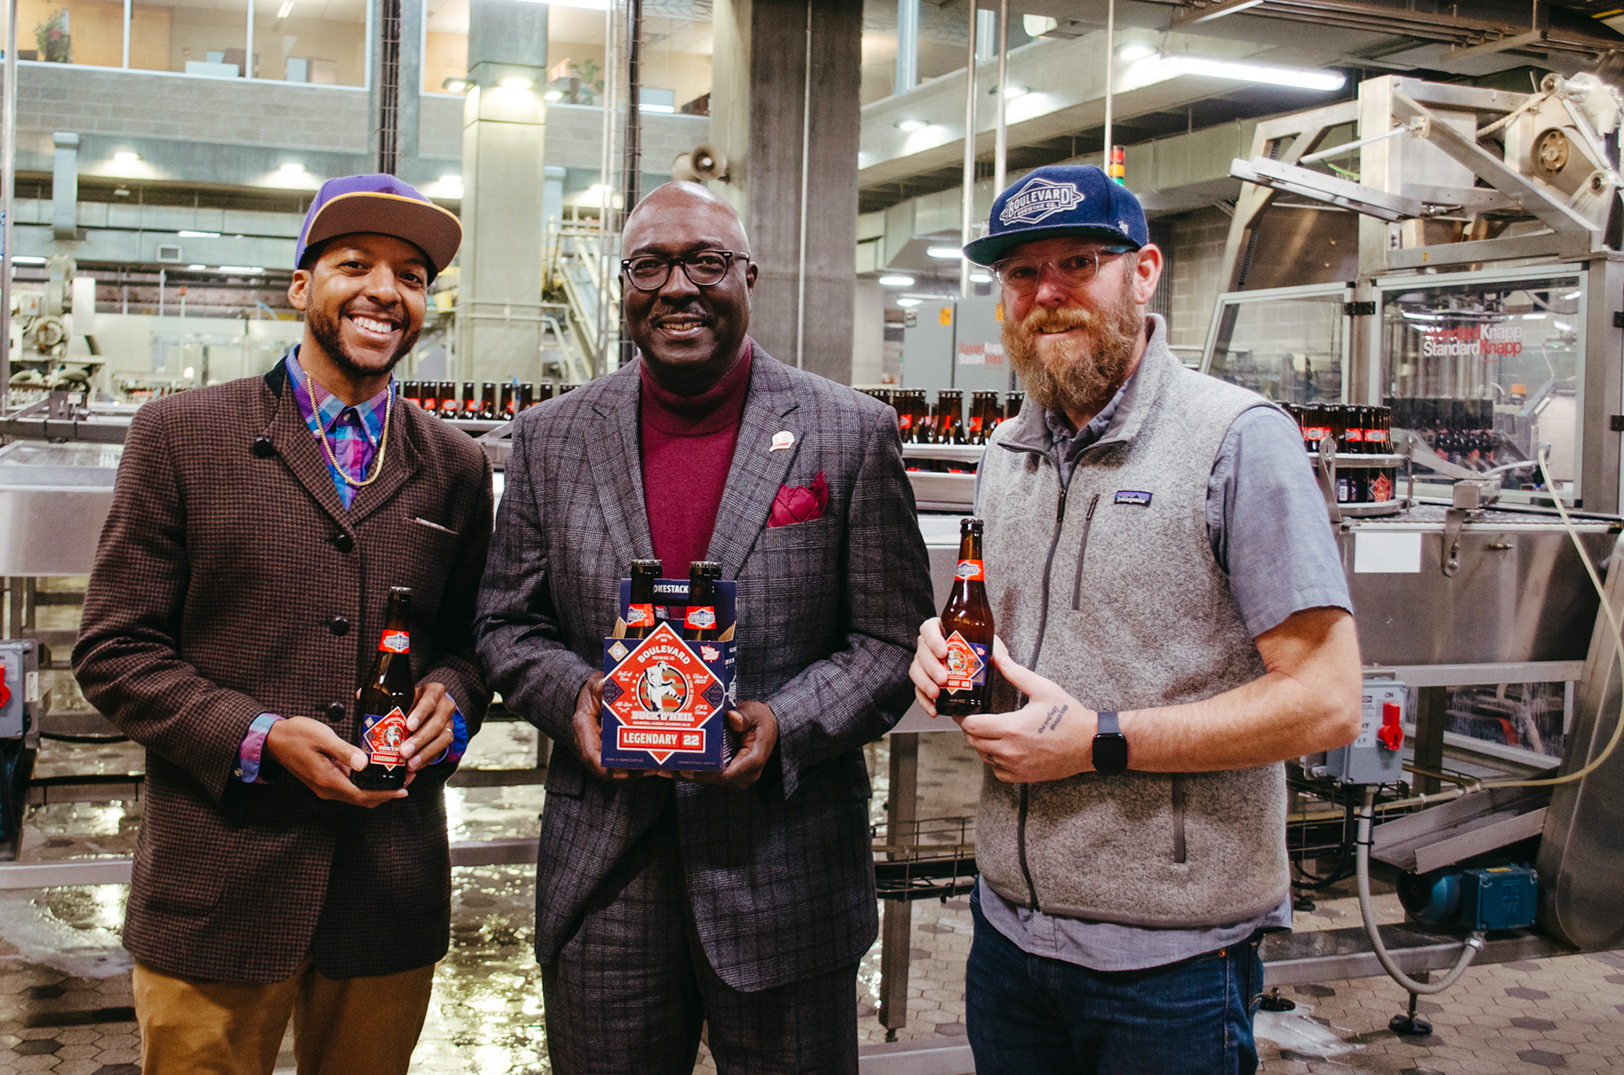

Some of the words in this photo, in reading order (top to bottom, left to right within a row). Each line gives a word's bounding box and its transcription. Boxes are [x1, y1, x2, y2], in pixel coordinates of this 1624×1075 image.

[1008, 188, 1070, 218] BOULEVARD
[1017, 203, 1045, 216] BREWING
[653, 584, 689, 594] OKESTACK
[637, 645, 691, 665] BOULEVARD
[631, 711, 659, 721] BUCK
[660, 712, 695, 723] O'NEIL
[623, 732, 678, 745] LEGENDARY
[683, 734, 700, 746] 22
